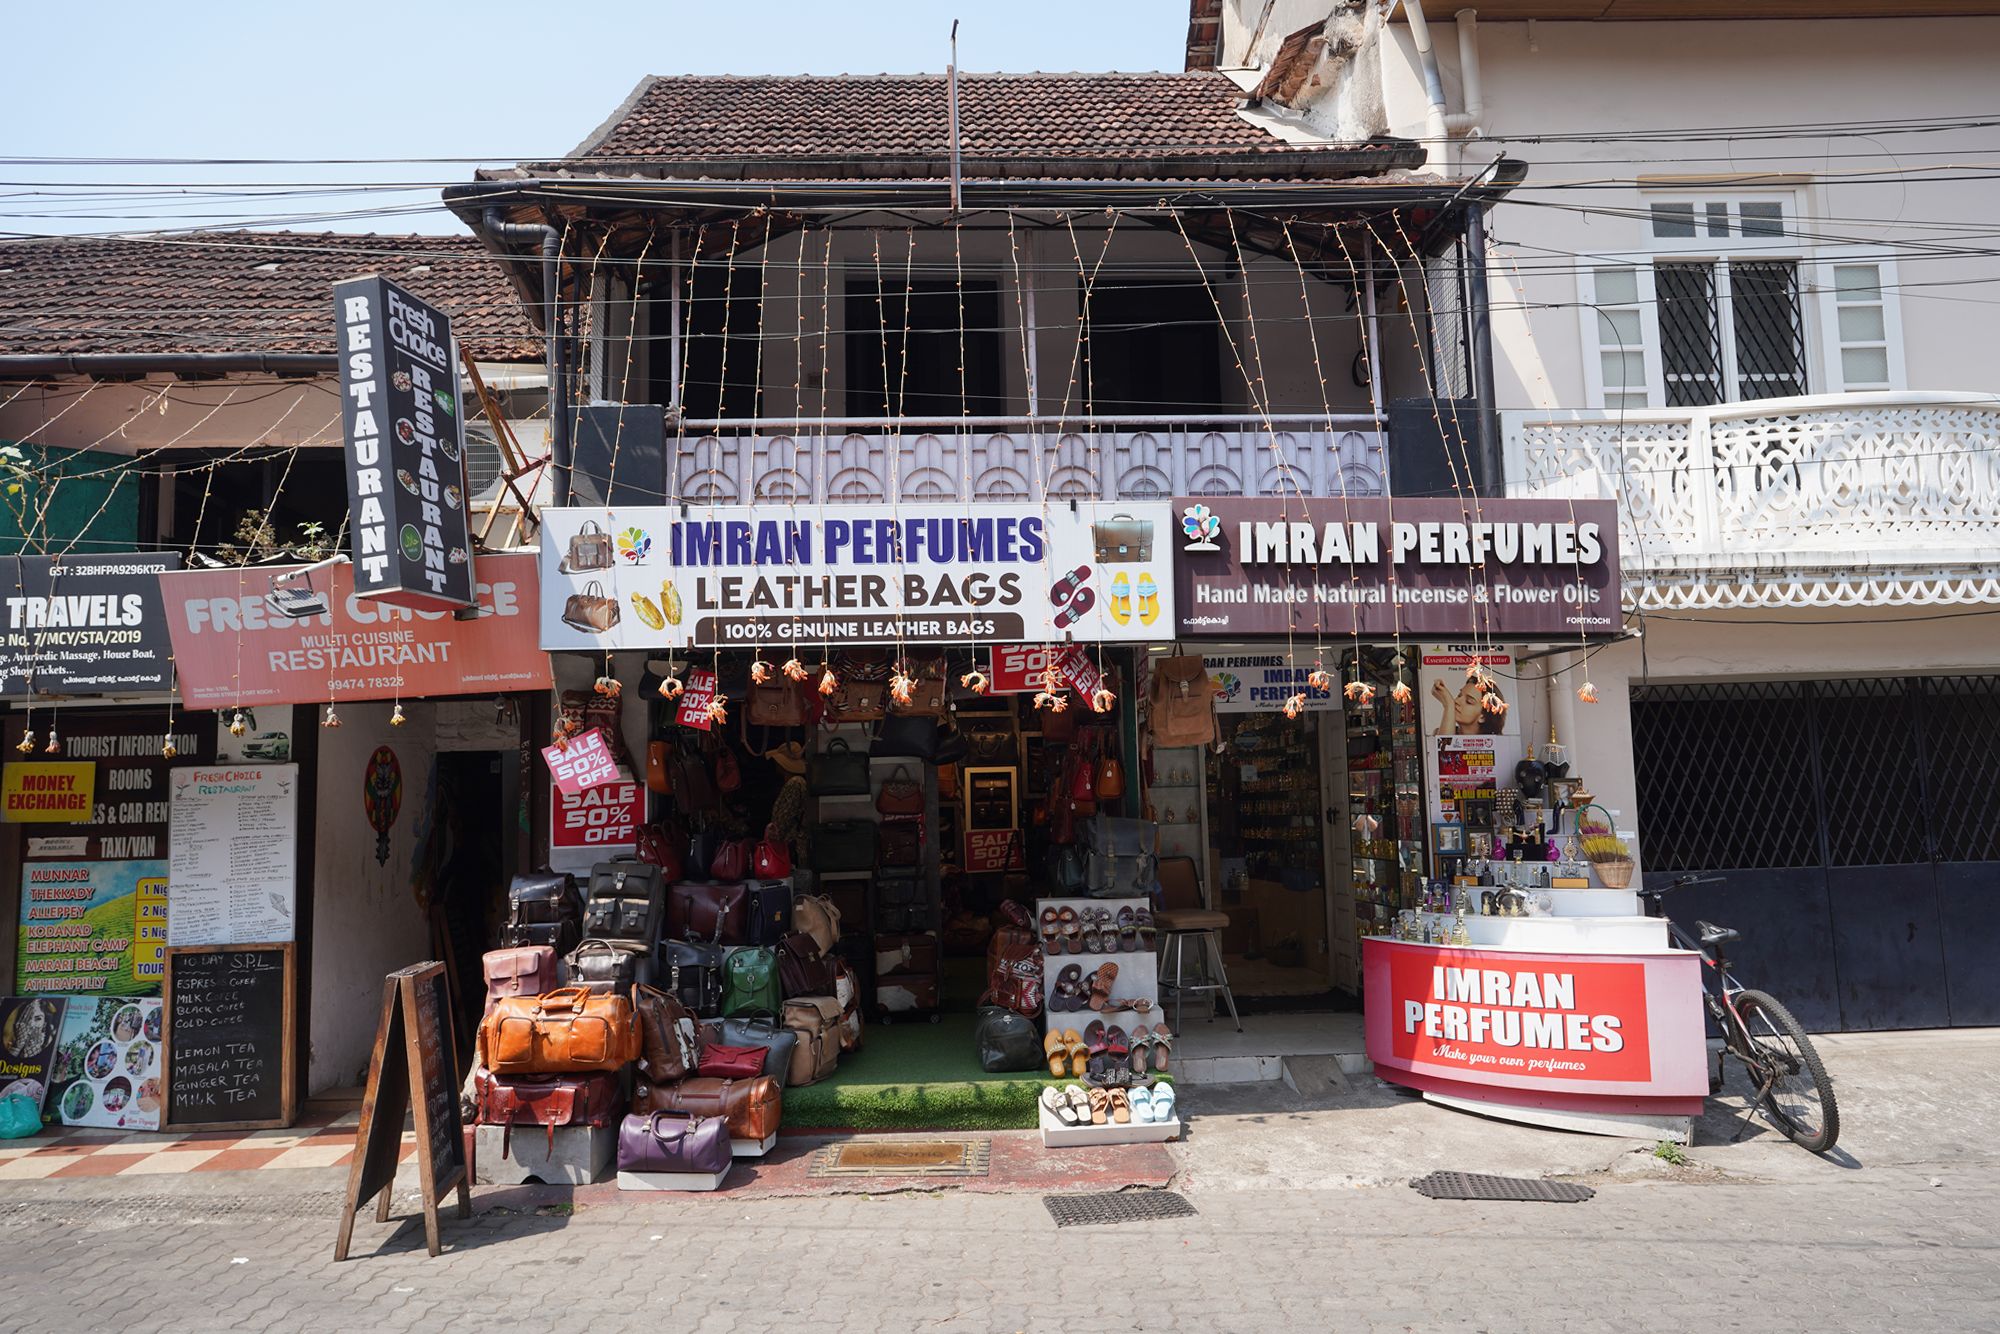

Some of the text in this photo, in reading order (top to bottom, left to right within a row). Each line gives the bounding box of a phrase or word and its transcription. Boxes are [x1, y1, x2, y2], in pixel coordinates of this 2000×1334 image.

[388, 289, 435, 338] Fresh
[389, 316, 447, 367] Choice
[344, 296, 388, 583] RESTAURANT
[411, 364, 446, 593] RESTAURANT
[672, 517, 1046, 566] IMRAN PERFUMES
[1240, 522, 1601, 564] IMRAN PERFUMES
[49, 566, 68, 576] GST
[697, 572, 1022, 610] LEATHER BAGS
[1197, 583, 1600, 604] Hand Made Natural Incense & Flower Oils
[6, 594, 143, 629] TRAVELS
[725, 619, 995, 638] 100% GENUINE LEATHER BAGS
[1567, 617, 1610, 625] FORTKOCHI
[8, 633, 30, 646] No.
[33, 630, 142, 647] 7/MCY/STA/2019
[301, 630, 415, 649] MULTI CUISINE
[13, 651, 58, 664] Ayurvedic
[60, 651, 100, 663] Massage,
[103, 650, 130, 660] House
[133, 649, 156, 660] Boat,
[268, 642, 451, 672] RESTAURANT
[1227, 656, 1283, 667] PERFUMES
[10, 666, 33, 677] Show
[36, 665, 76, 676] Tickets...
[1062, 651, 1088, 680] SALE
[328, 677, 404, 690] 99474 78328
[685, 675, 715, 691] SALE
[1263, 668, 1315, 683] IMRAN
[681, 694, 710, 710] 50%
[683, 710, 709, 724] OFF
[66, 734, 198, 757] TOURIST INFORMTION
[547, 732, 602, 767] SALE
[556, 749, 607, 780] 50%
[22, 775, 76, 791] MONEY
[109, 768, 152, 790] ROOMS
[577, 764, 613, 787] OFF
[8, 794, 87, 810] EXCHANGE
[562, 785, 635, 809] SALE
[107, 806, 117, 824] &
[119, 802, 143, 823] CAR
[145, 801, 169, 822] REN
[565, 805, 631, 828] 50%
[584, 825, 634, 842] OFF
[971, 833, 1017, 848] SALE
[100, 836, 156, 858] TAXI/VAN
[973, 845, 1015, 860] 50%
[986, 857, 1017, 869] OFF
[31, 869, 89, 882] MUNNAR
[30, 887, 95, 901] THEKKADY
[144, 885, 149, 895] 1
[28, 906, 87, 919] ALLEPPEY
[142, 906, 149, 916] 2
[27, 925, 93, 938] KODANAD
[141, 928, 148, 938] 5
[26, 939, 129, 954] ELEPHANT CAMP
[25, 958, 119, 973] MARARI BEACH
[24, 976, 107, 991] ATHIRAPPILLY
[1432, 965, 1576, 1011] IMRAN
[176, 993, 203, 1004] MILK
[176, 1005, 213, 1016] BLACK
[1404, 999, 1626, 1053] PERFUMES
[175, 1043, 256, 1060] LEMON TEA
[1433, 1043, 1586, 1072] Make your own perfumes
[175, 1058, 264, 1077] MASALA TEA
[173, 1073, 260, 1091] GINGER TEA
[224, 1088, 257, 1104] TEA
